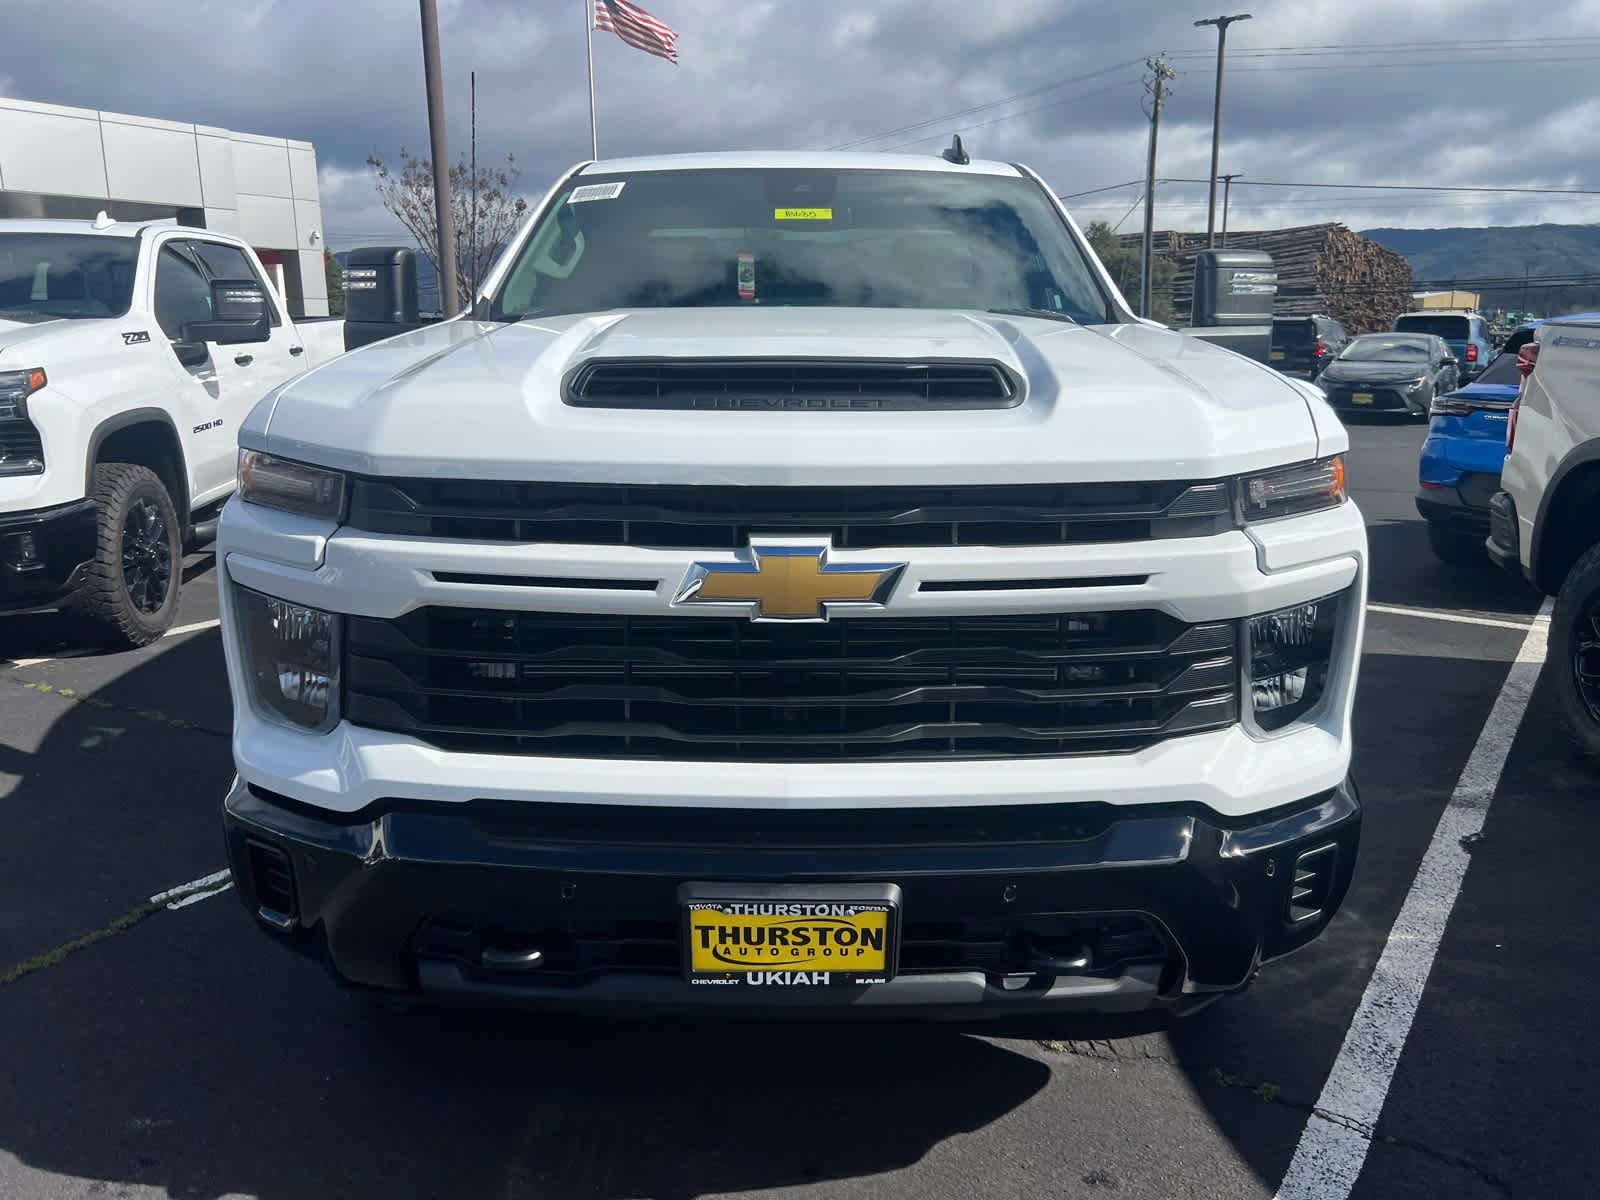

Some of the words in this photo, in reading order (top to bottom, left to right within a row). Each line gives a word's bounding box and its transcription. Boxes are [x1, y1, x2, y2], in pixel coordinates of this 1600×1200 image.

[690, 398, 891, 409] CHEVROLET
[193, 422, 212, 434] 2500
[213, 419, 223, 428] HD
[688, 903, 723, 911] TOYOTA
[730, 903, 846, 917] THURSTON
[694, 925, 884, 951] THURSTON
[723, 947, 780, 957] AUTO
[790, 947, 866, 957] GROUP
[746, 971, 831, 986] UKIAH
